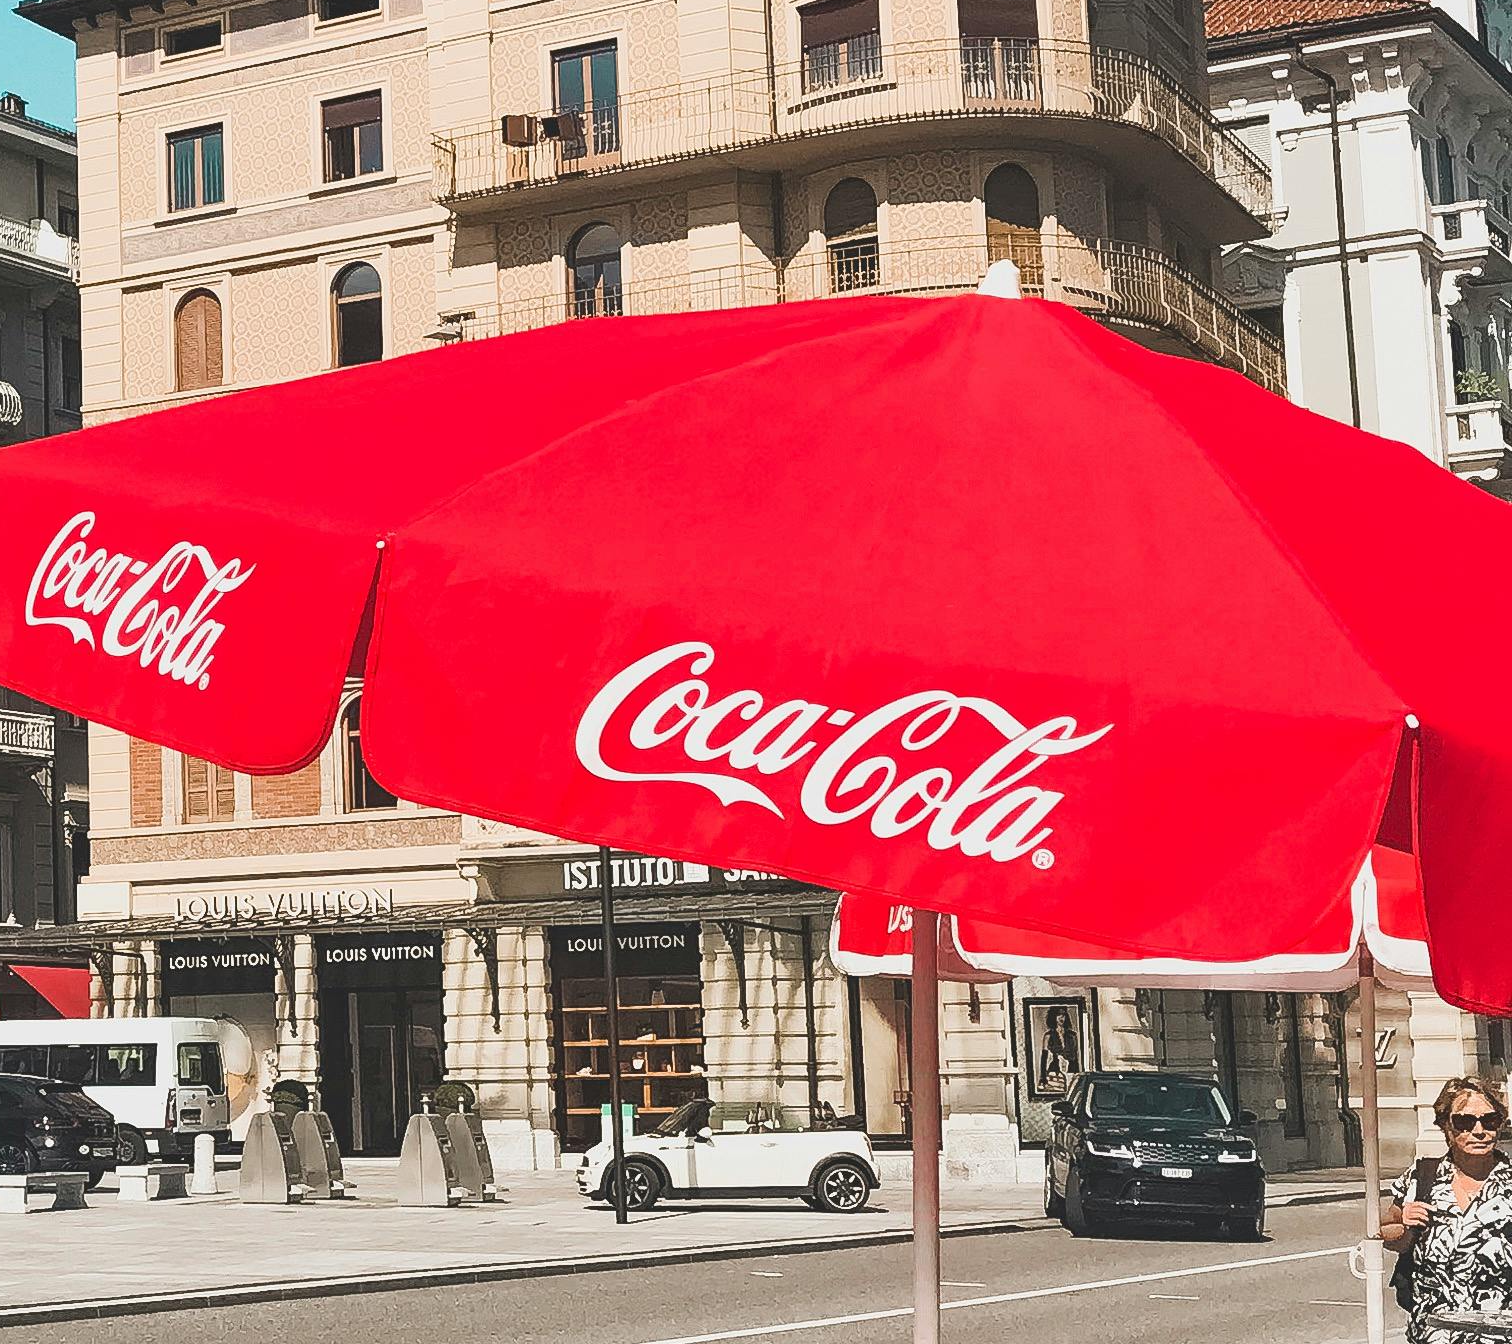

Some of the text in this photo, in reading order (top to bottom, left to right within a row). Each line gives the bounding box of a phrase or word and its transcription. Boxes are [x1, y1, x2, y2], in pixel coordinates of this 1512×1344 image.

[25, 511, 257, 686] Coca-Cola
[575, 641, 1115, 862] Coca-Cola
[563, 857, 674, 890] ISTTUTO
[173, 888, 393, 922] LOUIS VUITTON
[326, 945, 434, 962] LOUIS VUITTON
[568, 935, 685, 952] LOUI VUITTON
[169, 953, 270, 970] LOUIS VUITTON
